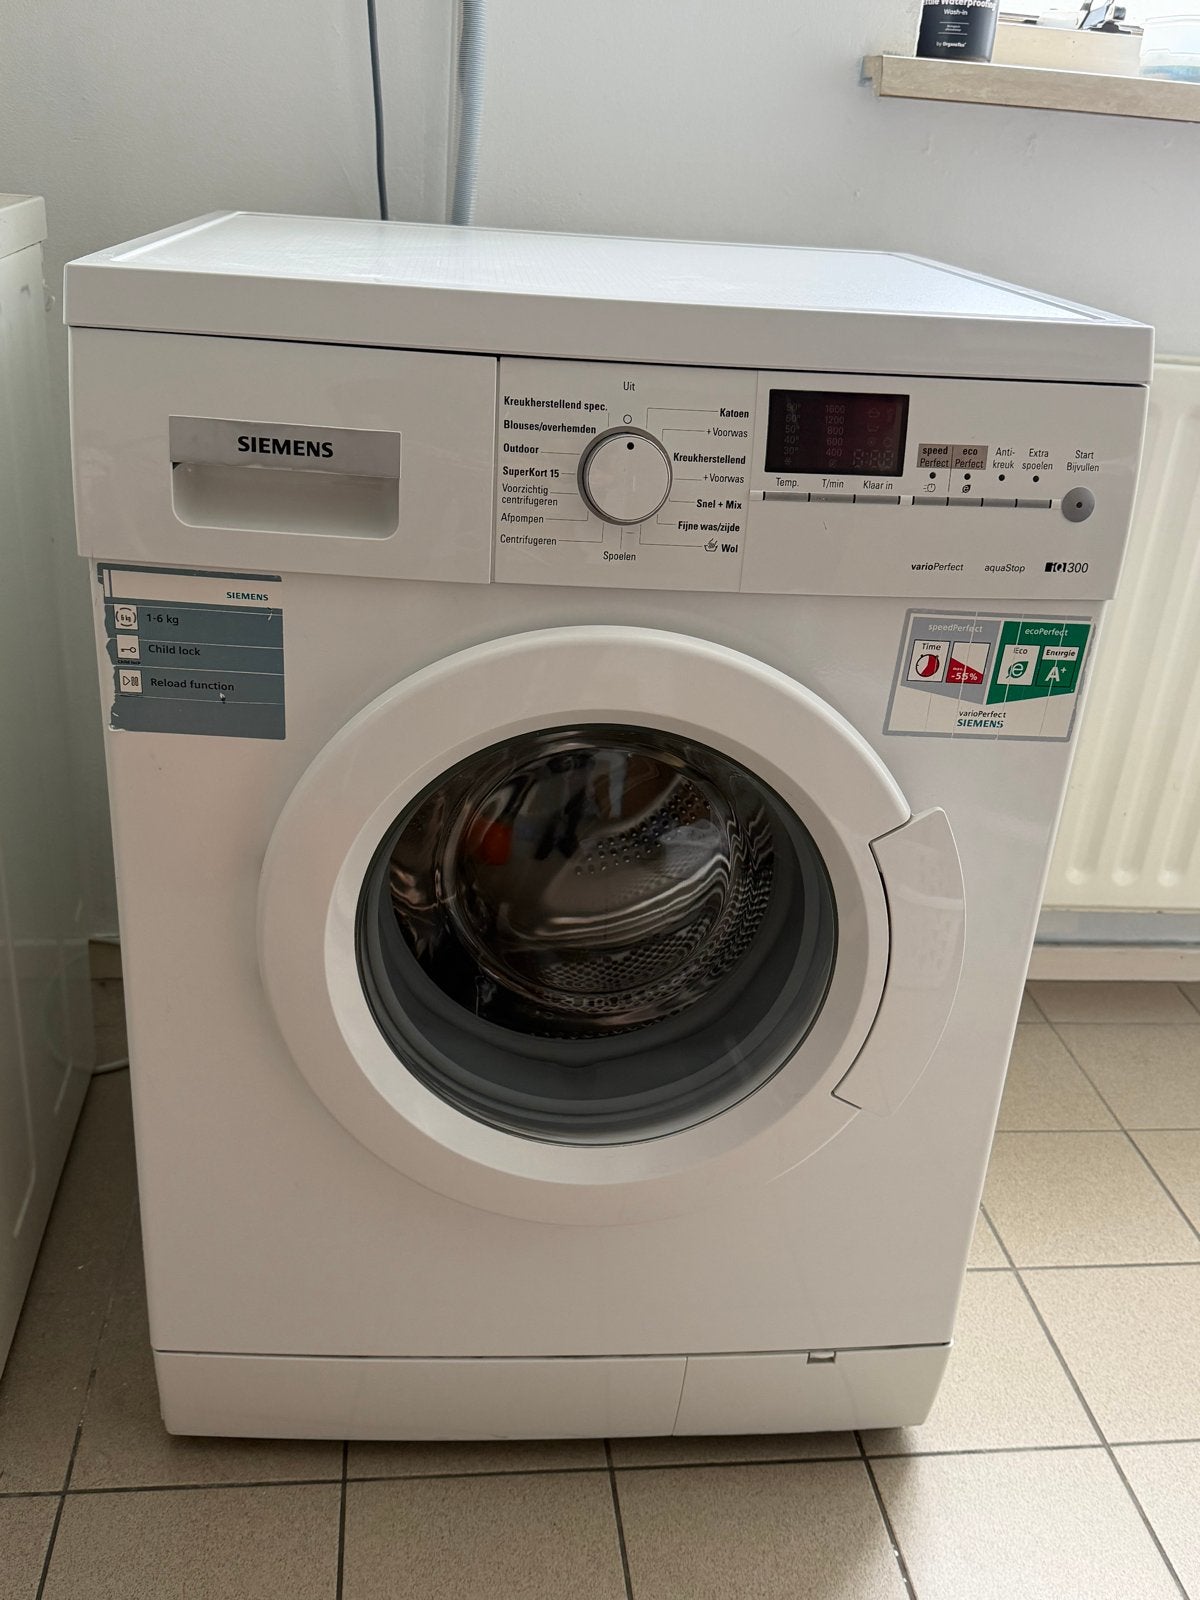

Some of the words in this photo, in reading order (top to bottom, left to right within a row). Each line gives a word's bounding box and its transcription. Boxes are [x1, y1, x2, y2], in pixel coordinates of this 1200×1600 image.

[623, 381, 635, 392] Uit
[503, 395, 582, 411] Kreukherstellend
[583, 402, 608, 413] spec.
[719, 407, 750, 419] Katoen
[503, 420, 597, 435] Blouses/overhemden
[237, 435, 334, 458] SIEMENS
[503, 443, 539, 455] Outdoor
[922, 446, 948, 457] speed
[962, 448, 978, 456] eco
[995, 447, 1015, 457] Anti-
[1028, 448, 1049, 458] Extra
[1075, 449, 1094, 459] Start
[673, 452, 746, 466] Kreukherstellend
[919, 457, 949, 469] Perfect
[954, 458, 984, 469] Perfect
[992, 460, 1015, 469] kreuk
[1021, 461, 1053, 471] spoelen
[1066, 462, 1100, 473] Bijvullen
[502, 466, 548, 479] SuperKort
[550, 469, 560, 479] 15
[775, 477, 800, 490] Temp.
[822, 478, 844, 489] T/min
[863, 479, 884, 490] Klaar
[885, 480, 893, 490] in
[501, 483, 549, 496] Voorzichtig
[501, 496, 558, 508] centrifugeren
[696, 499, 715, 509] Snel
[725, 500, 742, 510] Mix
[500, 512, 544, 525] Afpompen
[677, 520, 698, 532] Fijne
[700, 522, 740, 533] was/zijde
[500, 534, 557, 547] Centrifugeren
[721, 543, 738, 553] Wol
[603, 551, 636, 563] Spoelen
[911, 562, 964, 573] varioPerfect
[984, 563, 1026, 574] aquaStop
[226, 591, 269, 601] SIEMENS
[146, 613, 163, 623] 1-6
[166, 614, 179, 626] kg
[928, 624, 983, 633] speedPerfect
[1025, 627, 1069, 636] ecoPerfect
[148, 644, 176, 655] Child
[178, 646, 201, 656] lock
[922, 643, 942, 651] Time
[150, 677, 187, 689] Reload
[189, 679, 235, 691] function
[959, 710, 1007, 719] varioPerfect
[957, 719, 1004, 729] SIEMENS
